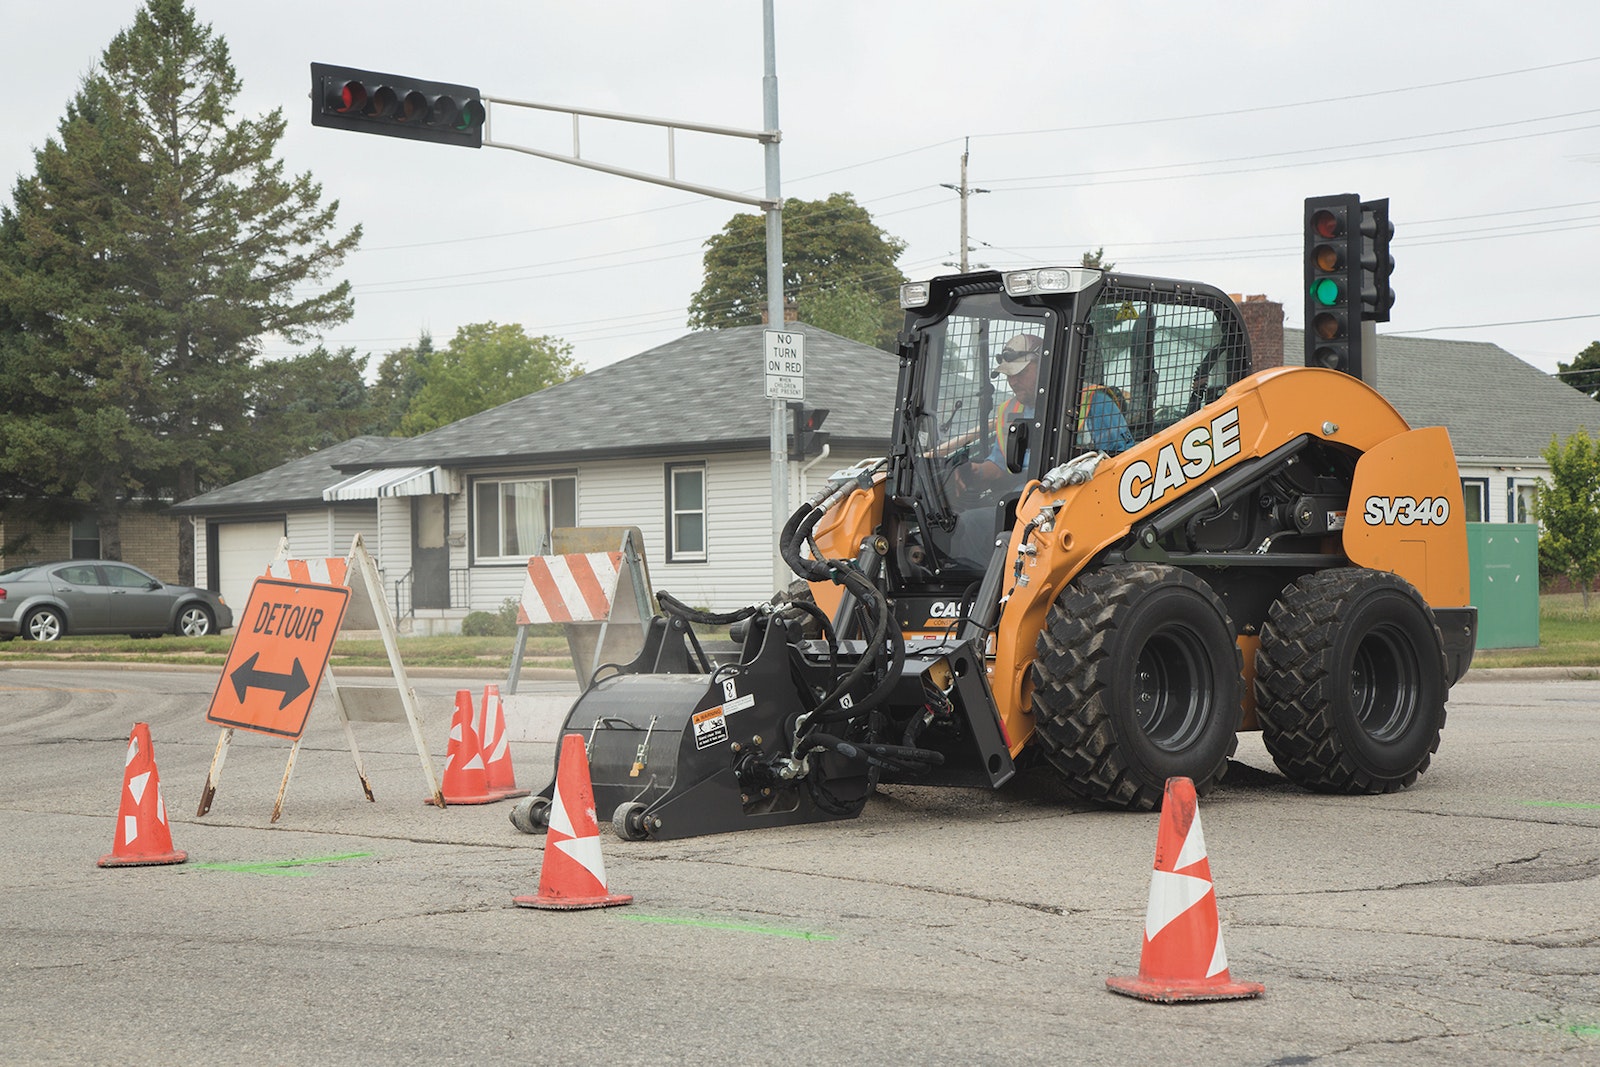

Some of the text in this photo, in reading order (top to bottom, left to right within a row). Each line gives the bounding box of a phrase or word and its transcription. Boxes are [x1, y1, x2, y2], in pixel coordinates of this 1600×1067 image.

[777, 334, 792, 344] NO
[774, 347, 796, 358] TURN
[769, 360, 801, 372] ON RED
[1118, 406, 1242, 514] CASE
[1363, 495, 1451, 526] SV340
[253, 601, 324, 642] DETOUR
